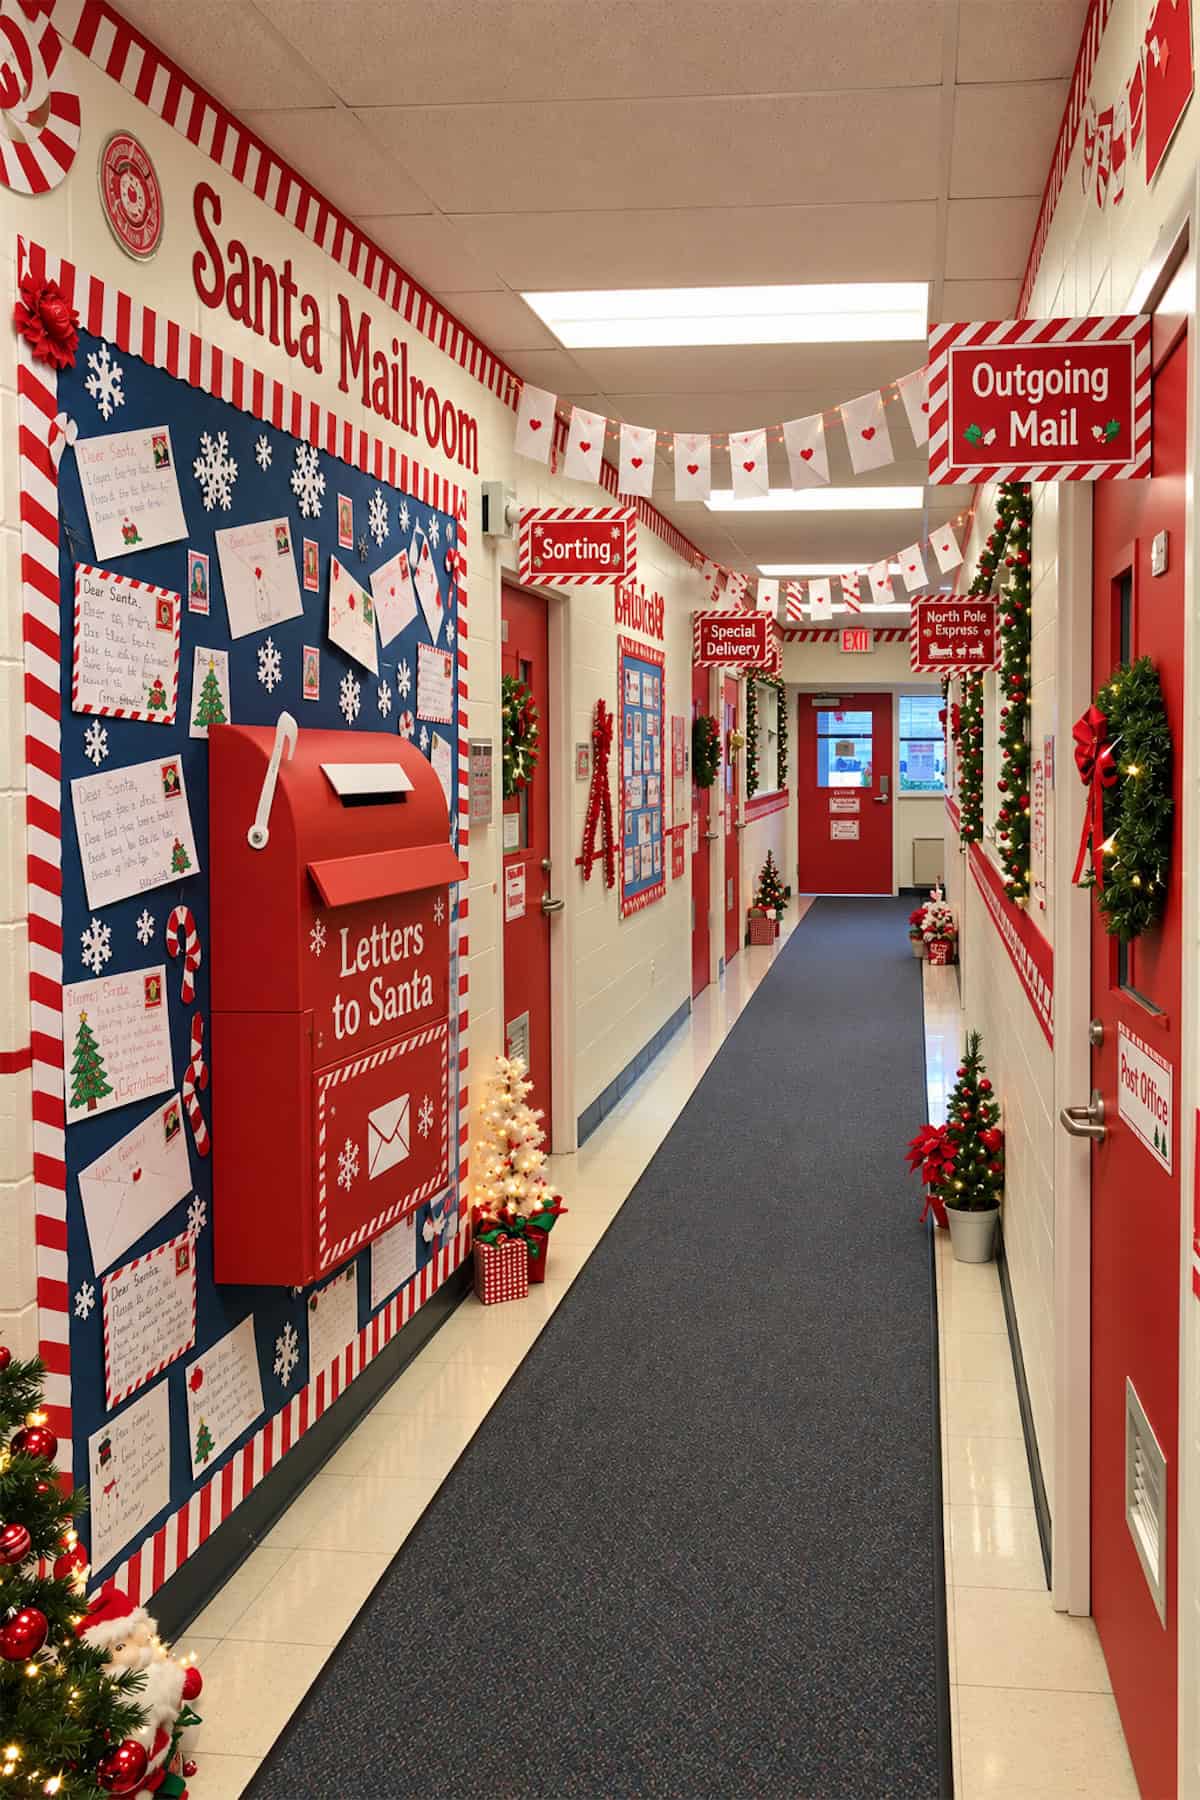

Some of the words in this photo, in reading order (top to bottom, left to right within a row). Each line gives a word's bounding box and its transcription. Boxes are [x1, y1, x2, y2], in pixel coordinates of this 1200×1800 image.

[192, 181, 323, 375] Santa
[337, 293, 479, 475] Mailroom
[972, 359, 1109, 404] Outgoing
[1009, 407, 1079, 447] Mail
[542, 537, 611, 565] Sorting
[83, 578, 106, 597] Dear
[927, 609, 960, 623] North
[963, 609, 987, 623] Pole
[711, 623, 757, 641] Special
[843, 630, 869, 650] EXIT
[935, 623, 979, 640] Express
[707, 641, 760, 659] Delivery
[78, 785, 102, 804] Dear
[339, 921, 425, 978] Letters
[332, 993, 361, 1040] to
[369, 969, 433, 1027] Santa
[1120, 1052, 1139, 1097] Post
[1140, 1072, 1168, 1126] Office
[111, 1280, 130, 1302] Dear
